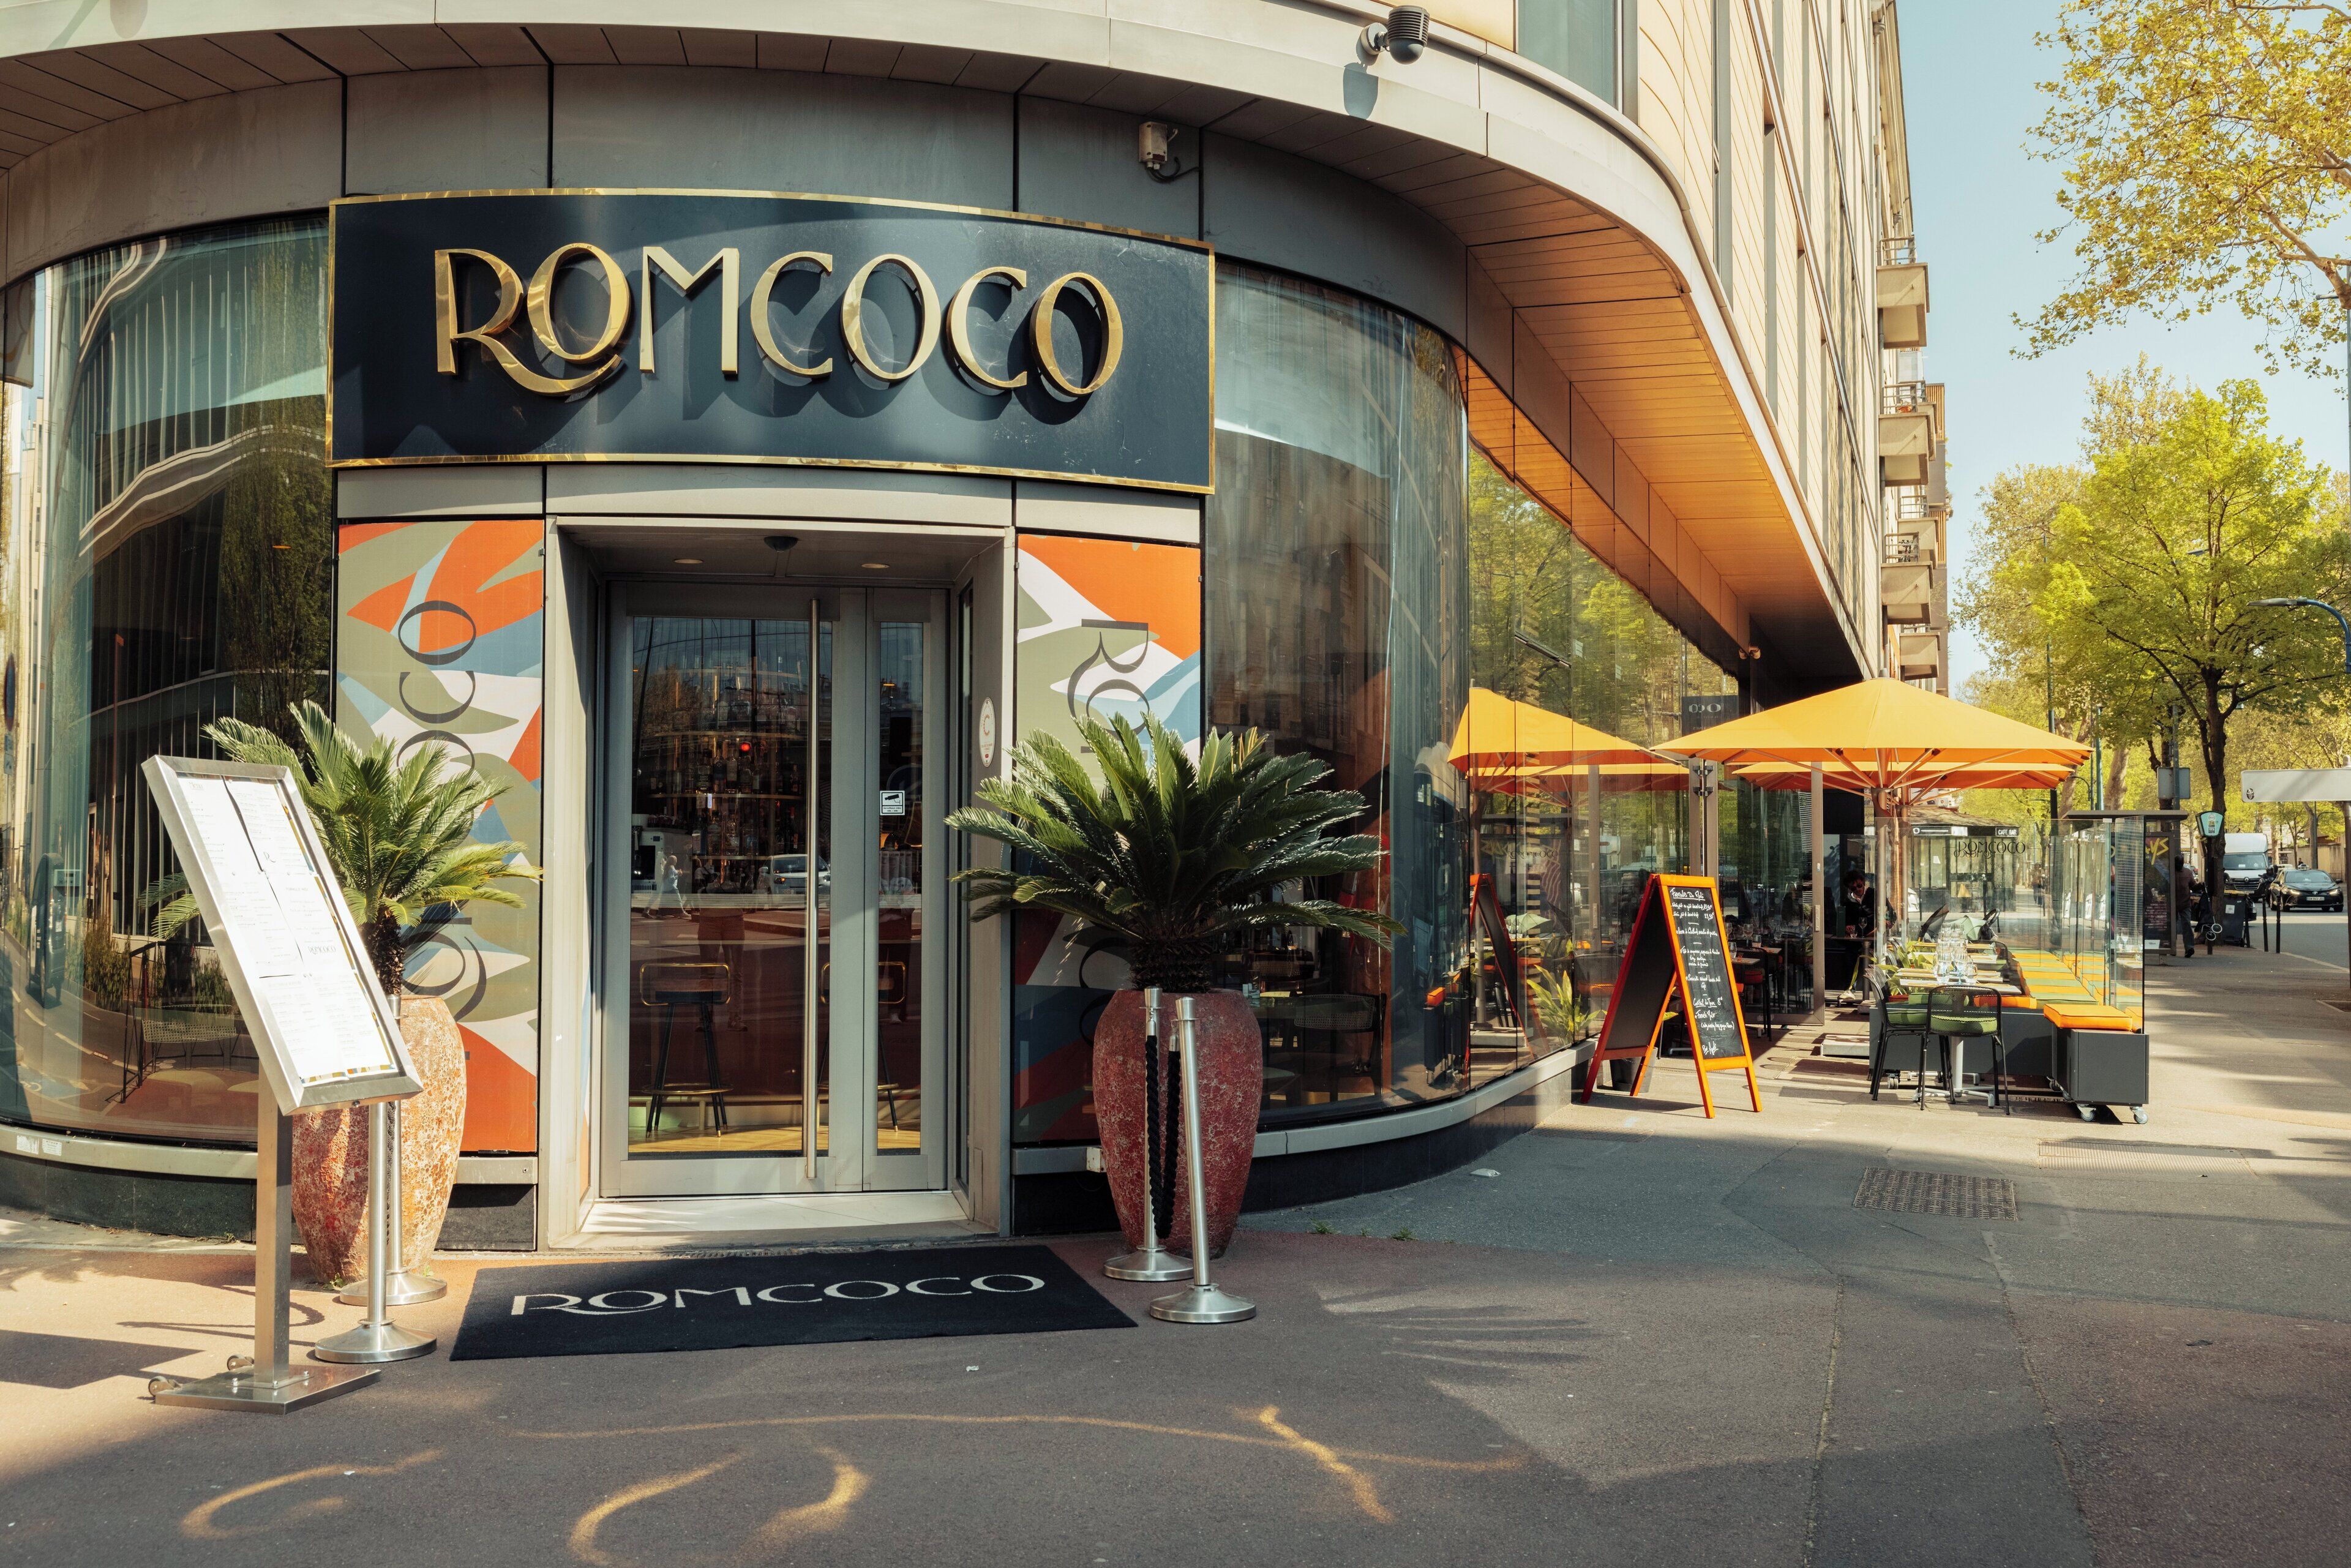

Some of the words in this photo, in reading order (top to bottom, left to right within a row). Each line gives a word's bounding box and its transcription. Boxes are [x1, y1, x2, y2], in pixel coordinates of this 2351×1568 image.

[435, 243, 1123, 397] ROMCOCO
[1957, 841, 2026, 855] ROMCOCO
[512, 1274, 1044, 1315] ROMCOCO
